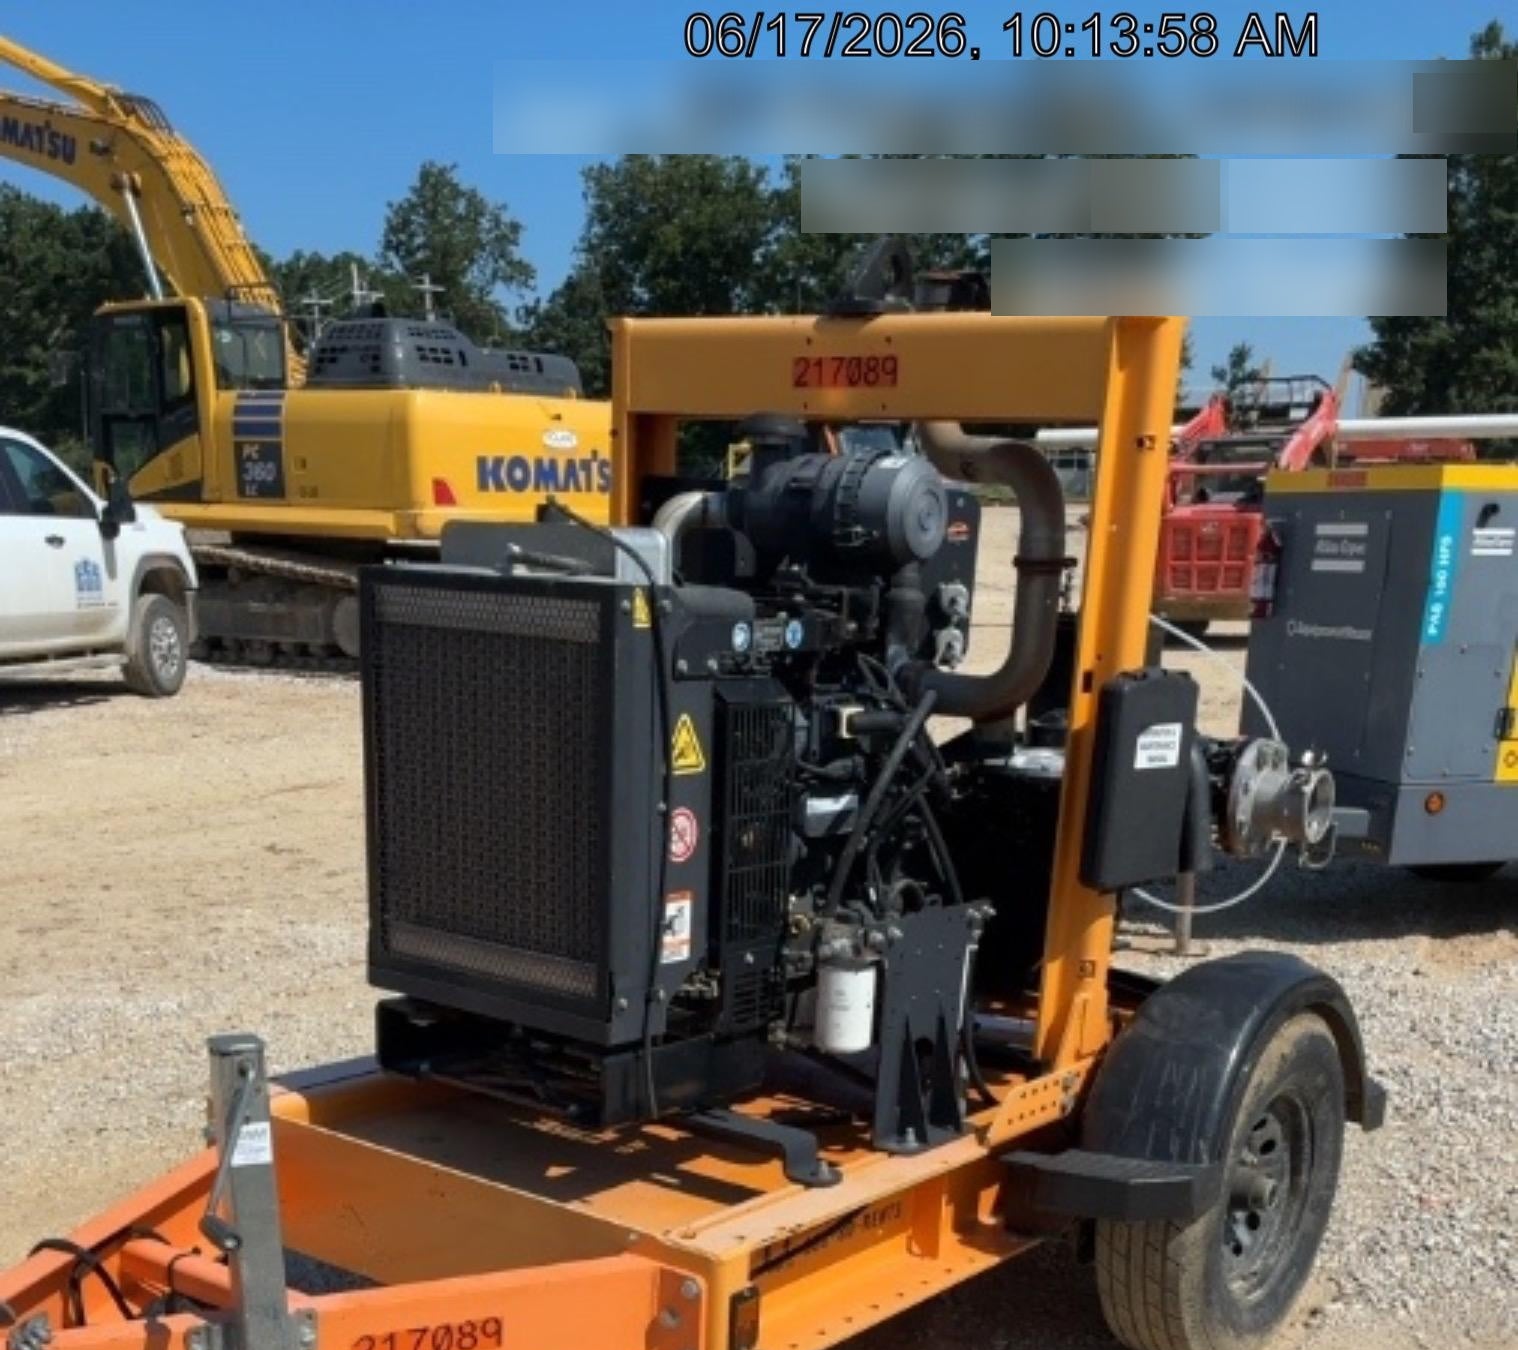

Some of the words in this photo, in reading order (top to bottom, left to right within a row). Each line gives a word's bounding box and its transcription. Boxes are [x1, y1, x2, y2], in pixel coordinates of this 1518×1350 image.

[0, 115, 77, 166] MATSU
[792, 355, 899, 388] 217089
[476, 449, 614, 494] KOMATS
